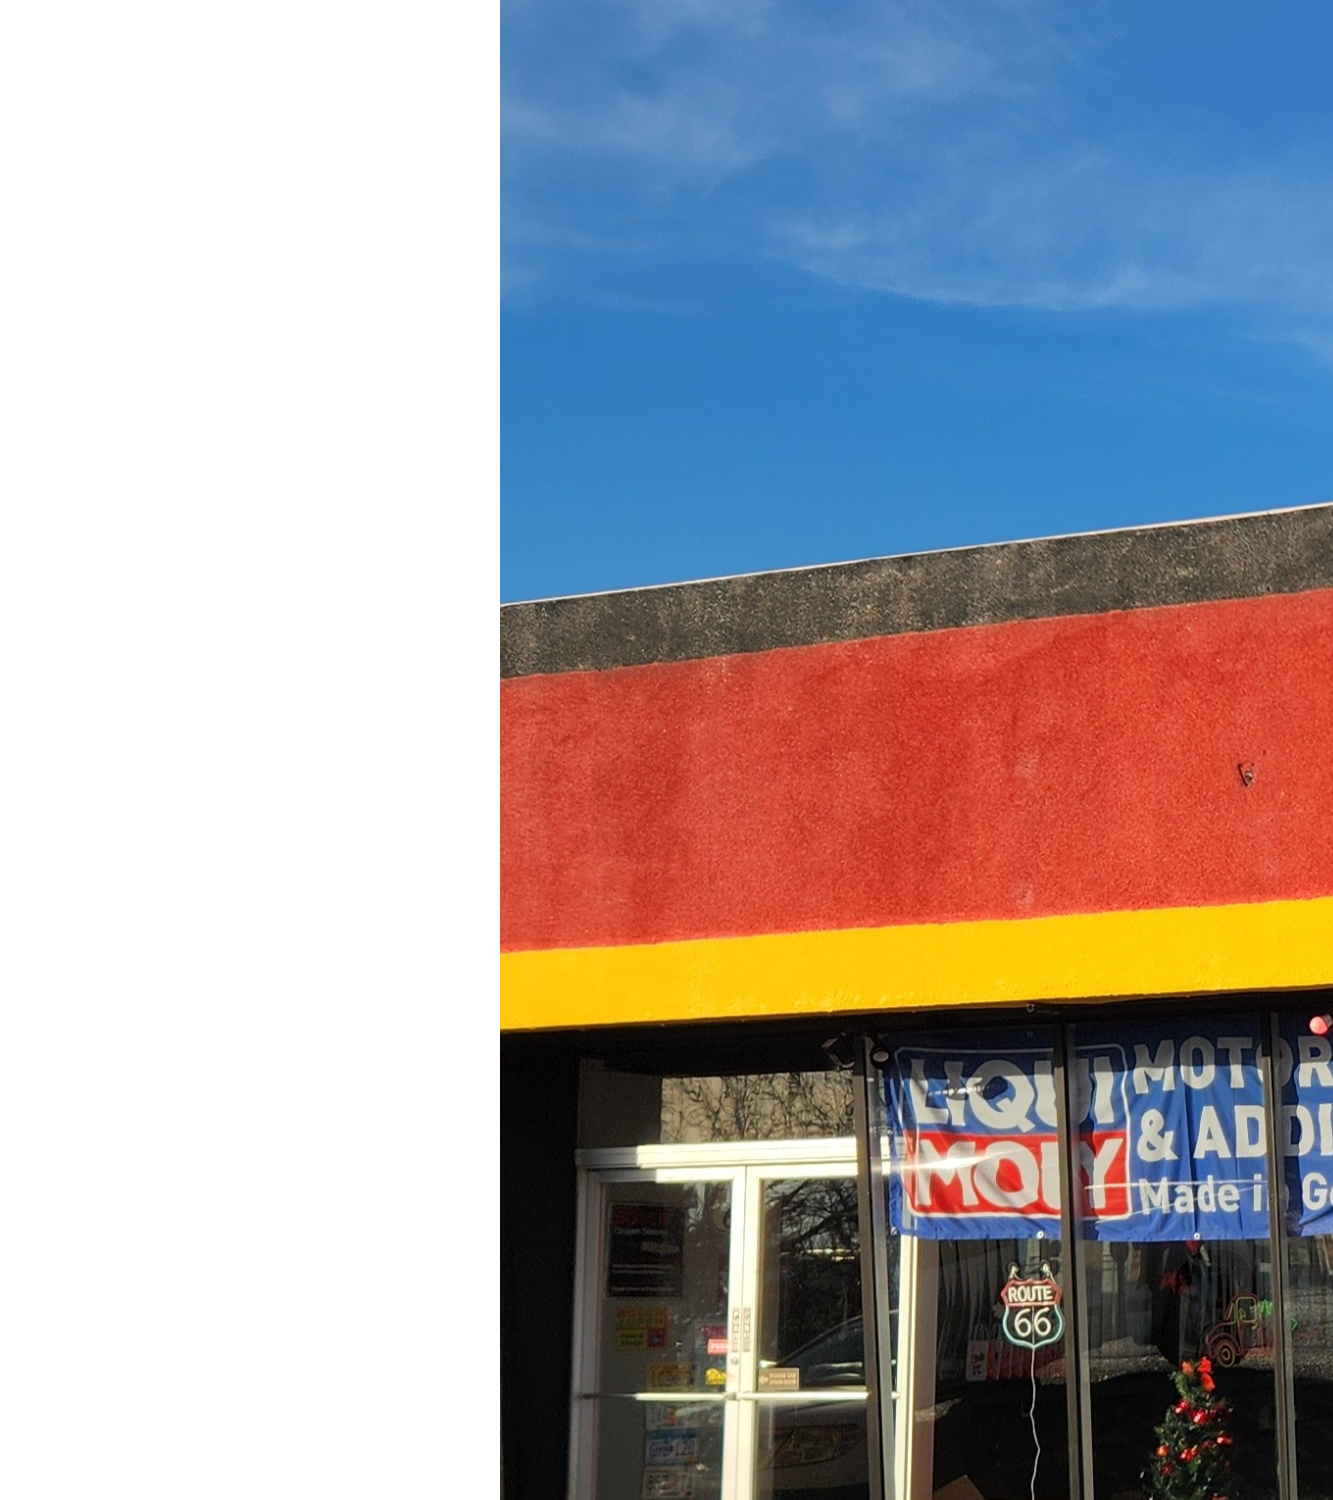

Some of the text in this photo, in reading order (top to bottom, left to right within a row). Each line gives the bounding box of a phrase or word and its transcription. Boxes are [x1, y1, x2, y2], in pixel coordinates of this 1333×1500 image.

[909, 1056, 1116, 1133] LIQUI
[1138, 1109, 1179, 1162] &
[1139, 1174, 1239, 1215] Made
[1008, 1285, 1053, 1303] ROUTE
[1014, 1307, 1052, 1337] 66
